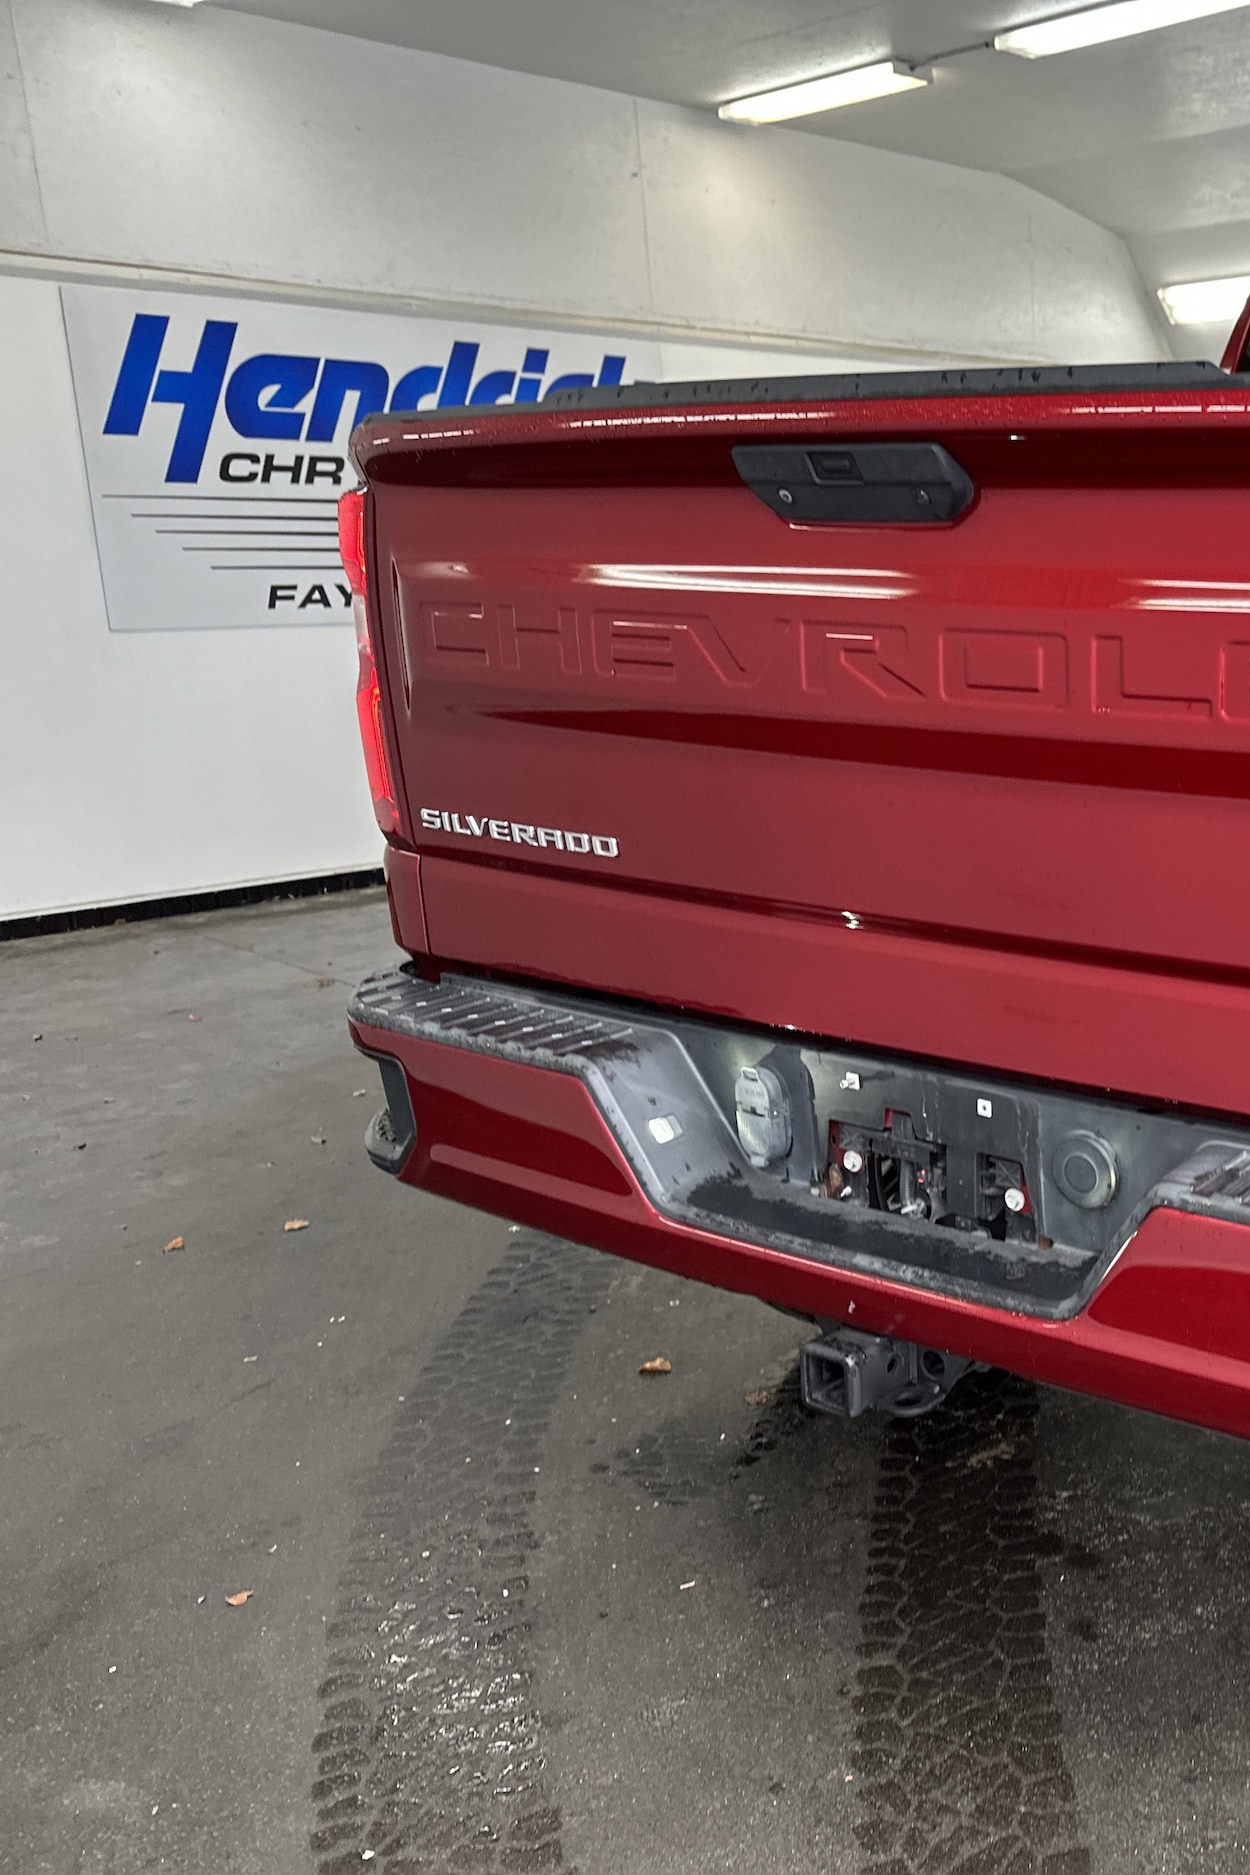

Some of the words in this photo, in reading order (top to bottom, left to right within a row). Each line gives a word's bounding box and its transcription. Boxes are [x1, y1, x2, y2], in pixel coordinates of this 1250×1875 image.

[102, 313, 626, 483] Hendri
[219, 452, 361, 486] CHR
[420, 808, 619, 857] SILVERADO
